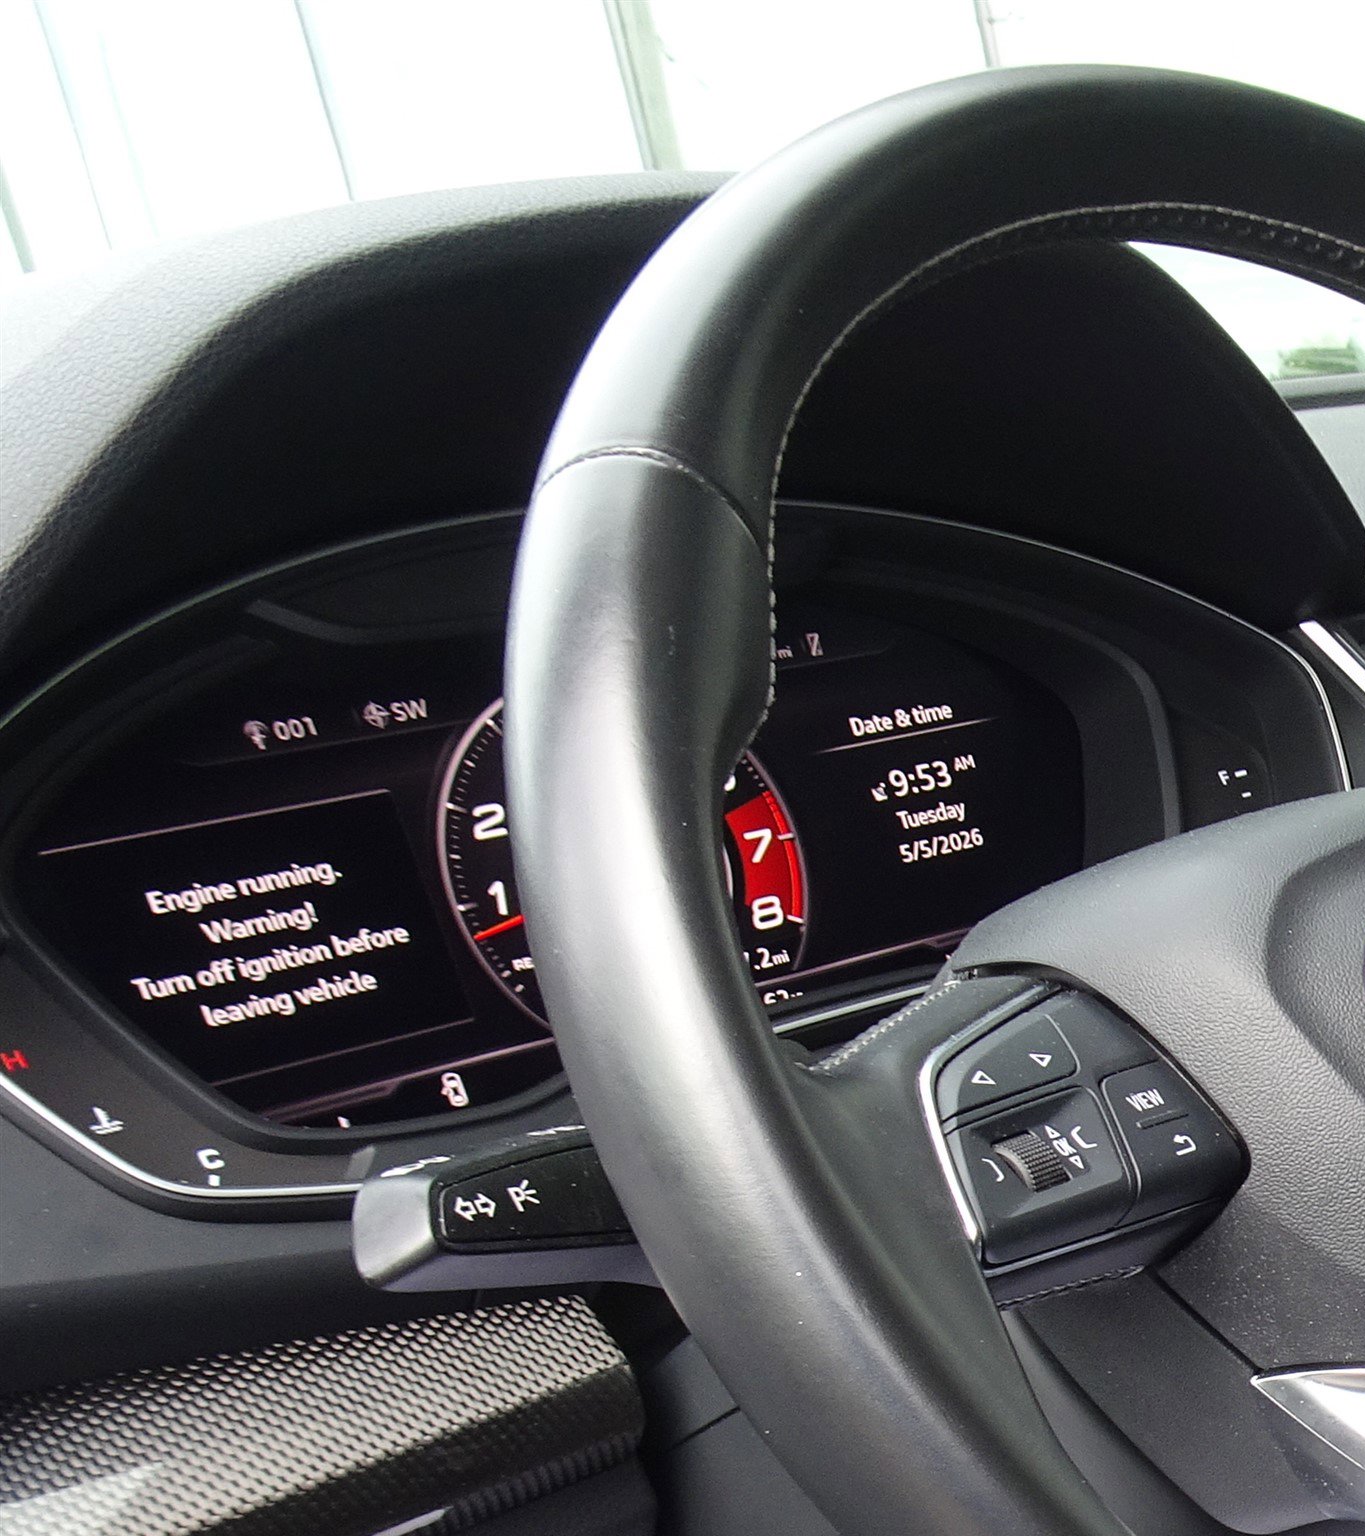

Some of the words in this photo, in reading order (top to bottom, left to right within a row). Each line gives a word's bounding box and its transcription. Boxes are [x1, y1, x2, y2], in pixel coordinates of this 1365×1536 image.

[390, 698, 428, 723] SW
[849, 713, 894, 737] Date
[894, 709, 912, 728] &
[912, 704, 953, 725] time
[272, 716, 318, 742] 001
[888, 760, 953, 798] 9:53
[953, 754, 976, 773] AM
[1217, 769, 1230, 786] F
[472, 803, 509, 841] 2
[896, 801, 966, 830] Tuesday
[743, 828, 773, 864] 7
[899, 827, 984, 864] 5/5/2026
[145, 883, 237, 915] Engine
[237, 862, 343, 897] running.
[487, 880, 509, 916] 1
[200, 901, 320, 944] Warning!
[751, 896, 784, 930] 8
[131, 974, 197, 1001] Turn
[197, 958, 236, 988] off
[235, 943, 334, 983] ignition
[330, 927, 411, 959] before
[200, 991, 296, 1028] leaving
[293, 971, 378, 1006] vehicle
[0, 1049, 30, 1072] H
[1125, 1088, 1165, 1113] VIEW
[197, 1148, 225, 1169] C
[1052, 1137, 1078, 1157] OK
